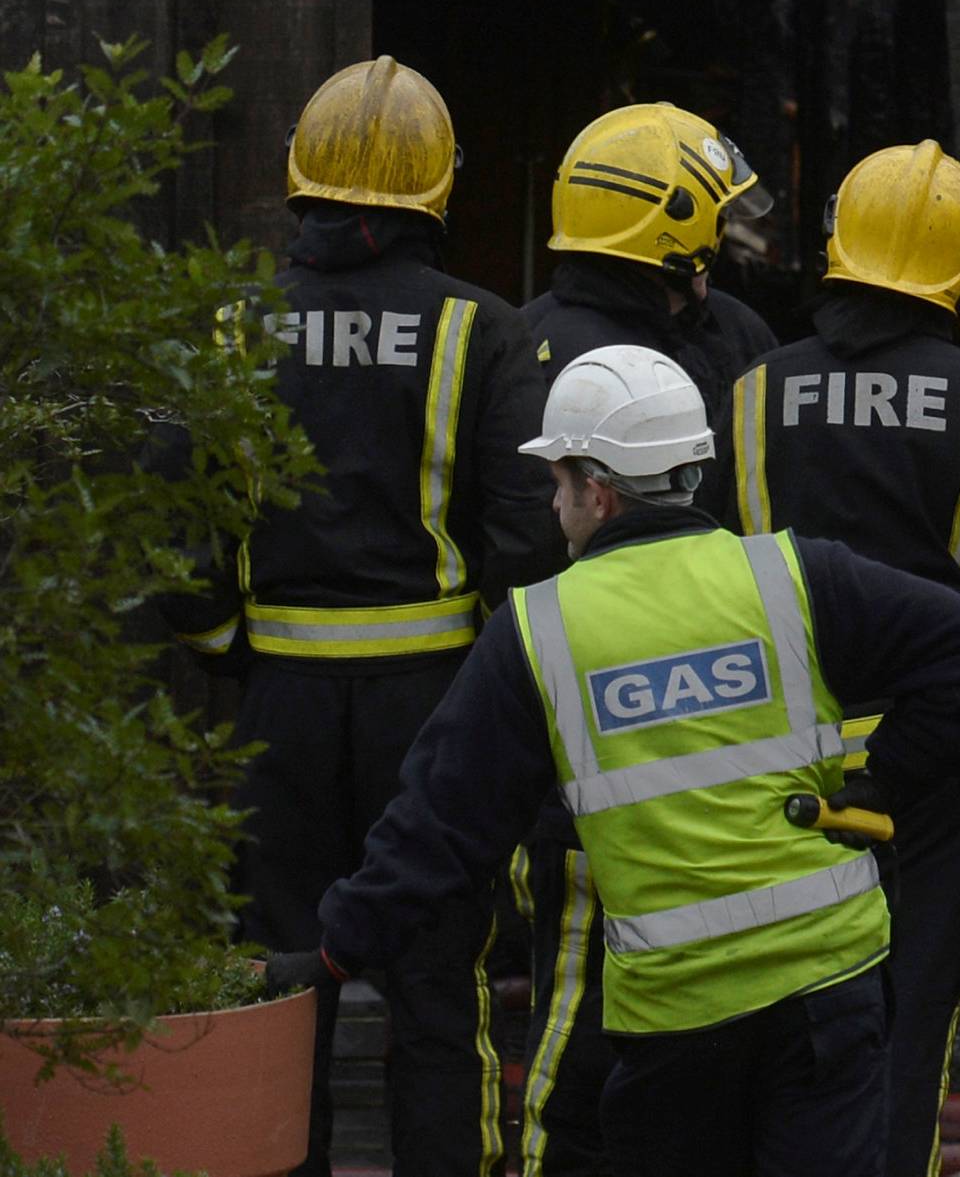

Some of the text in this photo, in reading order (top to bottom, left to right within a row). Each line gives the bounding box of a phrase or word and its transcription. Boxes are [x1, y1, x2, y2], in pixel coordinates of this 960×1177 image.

[263, 310, 421, 367] FIRE
[783, 371, 949, 432] FIRE
[604, 654, 757, 719] GAS
